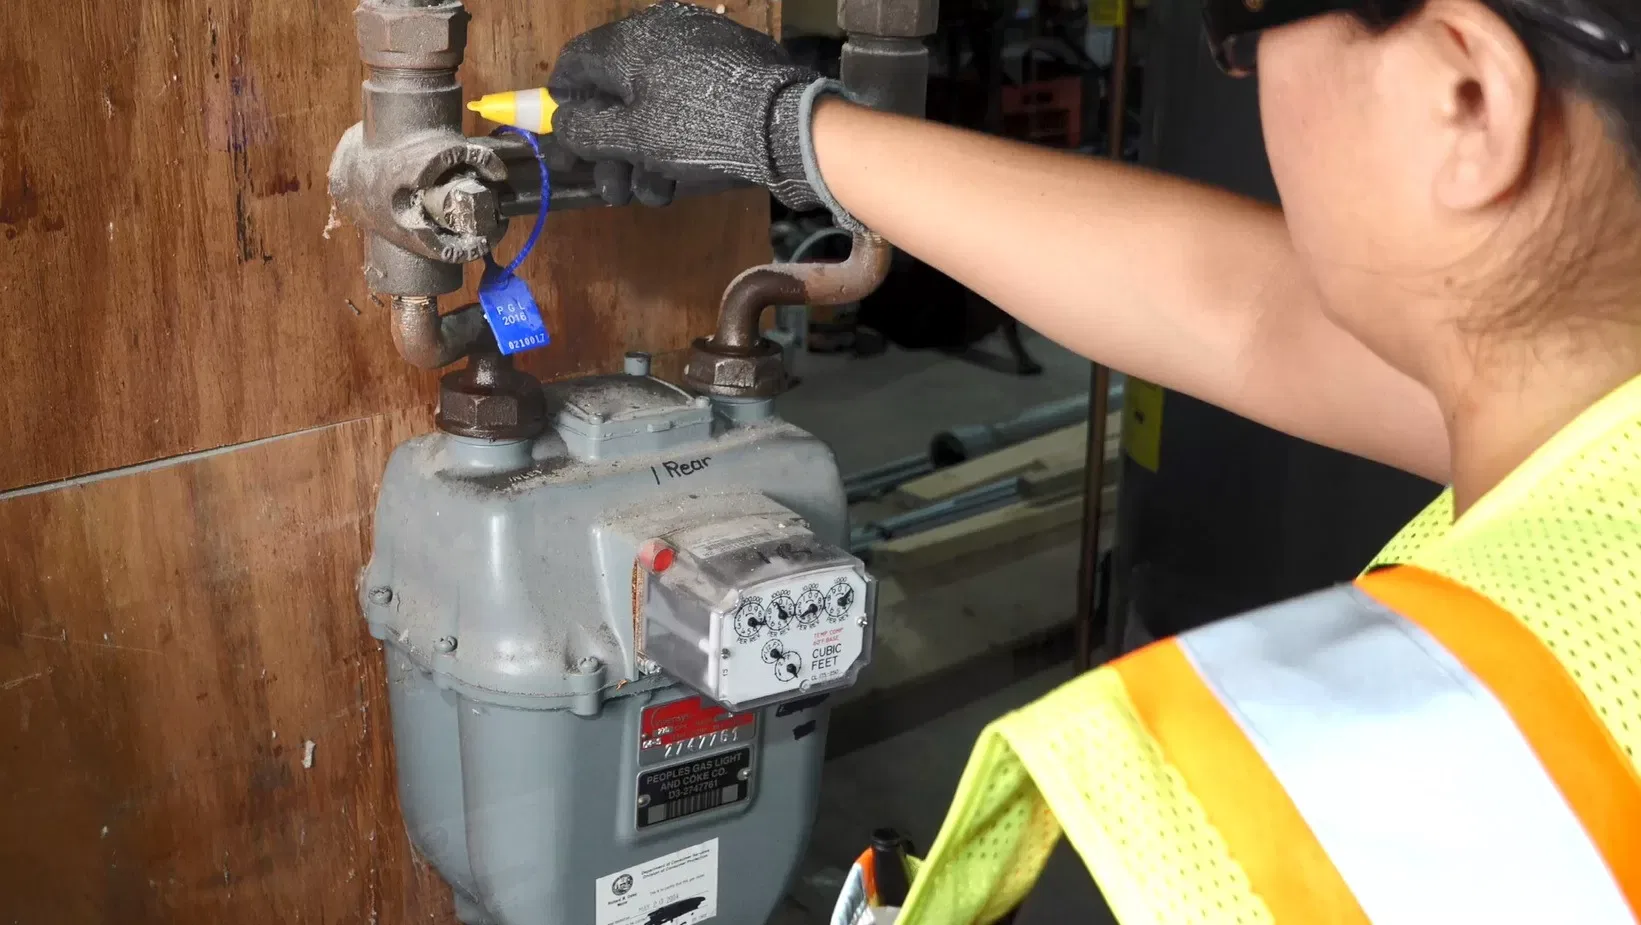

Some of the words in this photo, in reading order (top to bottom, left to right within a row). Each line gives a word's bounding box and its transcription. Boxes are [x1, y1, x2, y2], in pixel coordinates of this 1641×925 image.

[441, 239, 488, 263] OPEN
[496, 306, 504, 315] P
[508, 303, 516, 312] G
[517, 302, 526, 310] L
[502, 311, 527, 326] 2016
[508, 332, 546, 350] 0210017
[662, 456, 712, 479] Rear
[826, 635, 840, 644] BASE
[812, 643, 842, 658] CUBIC
[812, 656, 838, 670] FEET
[646, 766, 690, 785] PEOPLES
[692, 760, 713, 772] GAS
[715, 752, 742, 767] LIGHT
[660, 779, 681, 792] AND
[682, 771, 710, 786] COKE
[712, 767, 728, 778] CO.
[668, 779, 718, 800] D3-2747761
